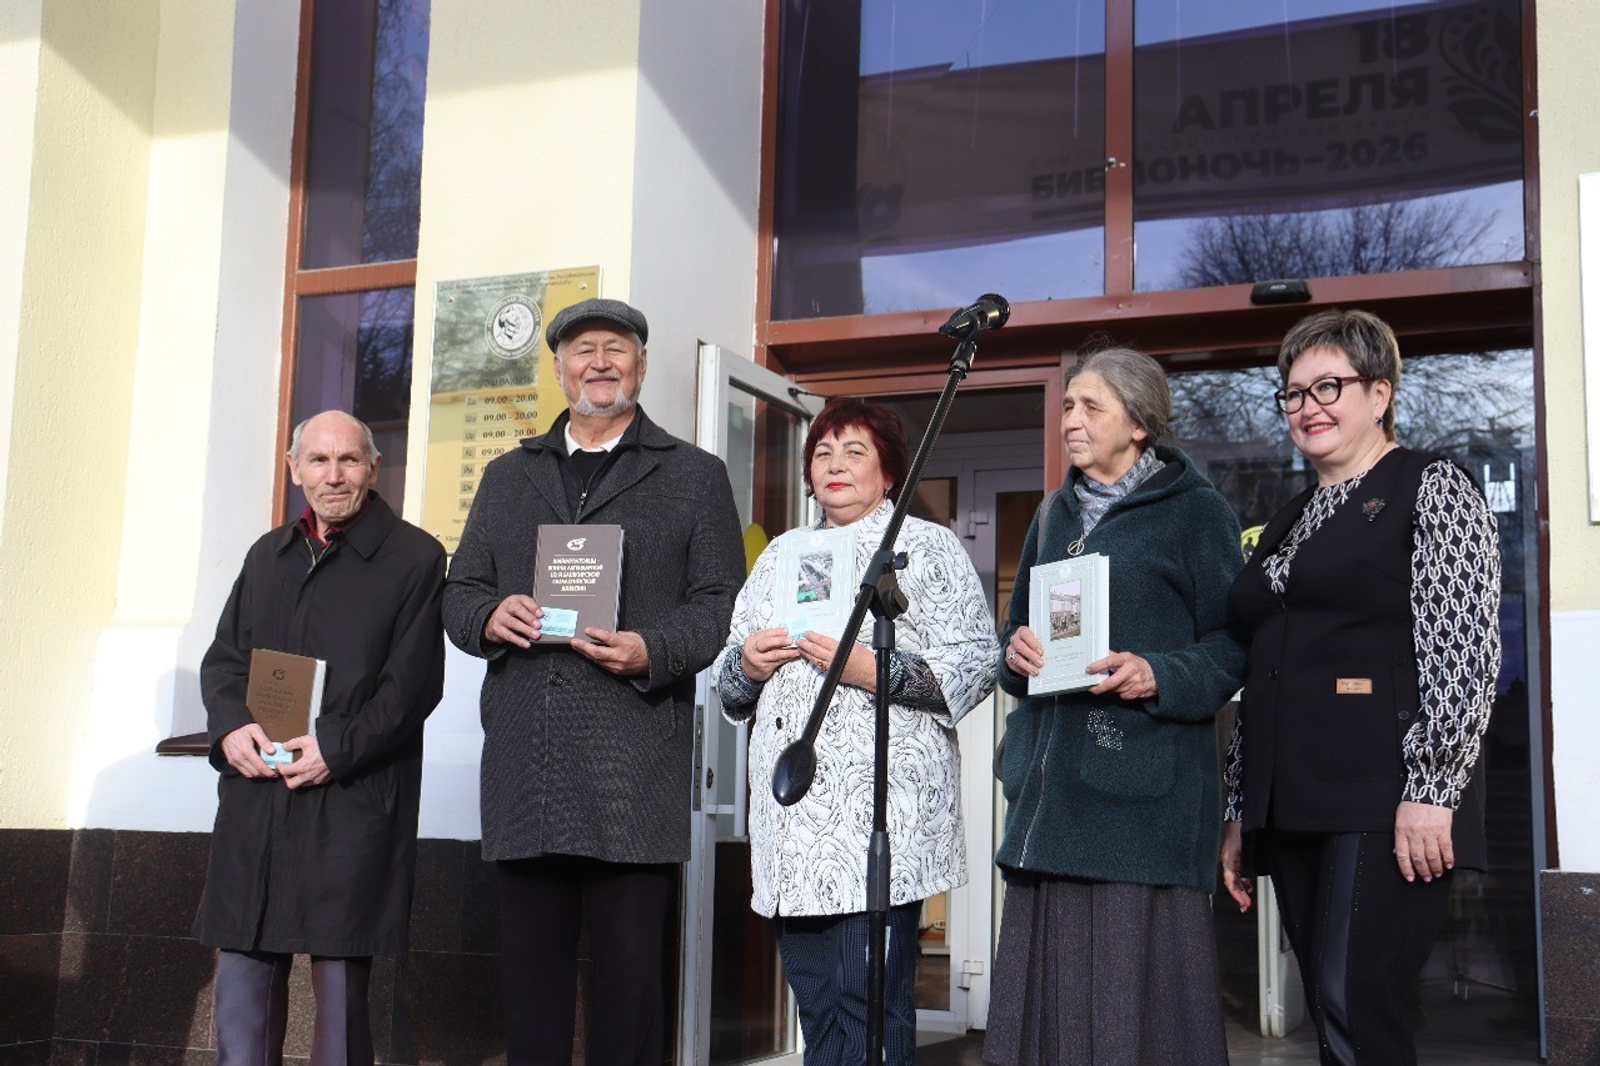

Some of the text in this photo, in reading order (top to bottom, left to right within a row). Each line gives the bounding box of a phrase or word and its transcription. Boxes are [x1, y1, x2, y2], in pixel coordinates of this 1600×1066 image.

[1351, 14, 1430, 64] 18
[1173, 67, 1430, 132] АПРЕЛЯ
[484, 396, 508, 405] 09.00
[515, 393, 538, 403] 20.00
[483, 413, 507, 422] 09.00
[515, 411, 538, 420] 20.00
[482, 430, 506, 439] 09.00
[514, 428, 537, 438] 20.00
